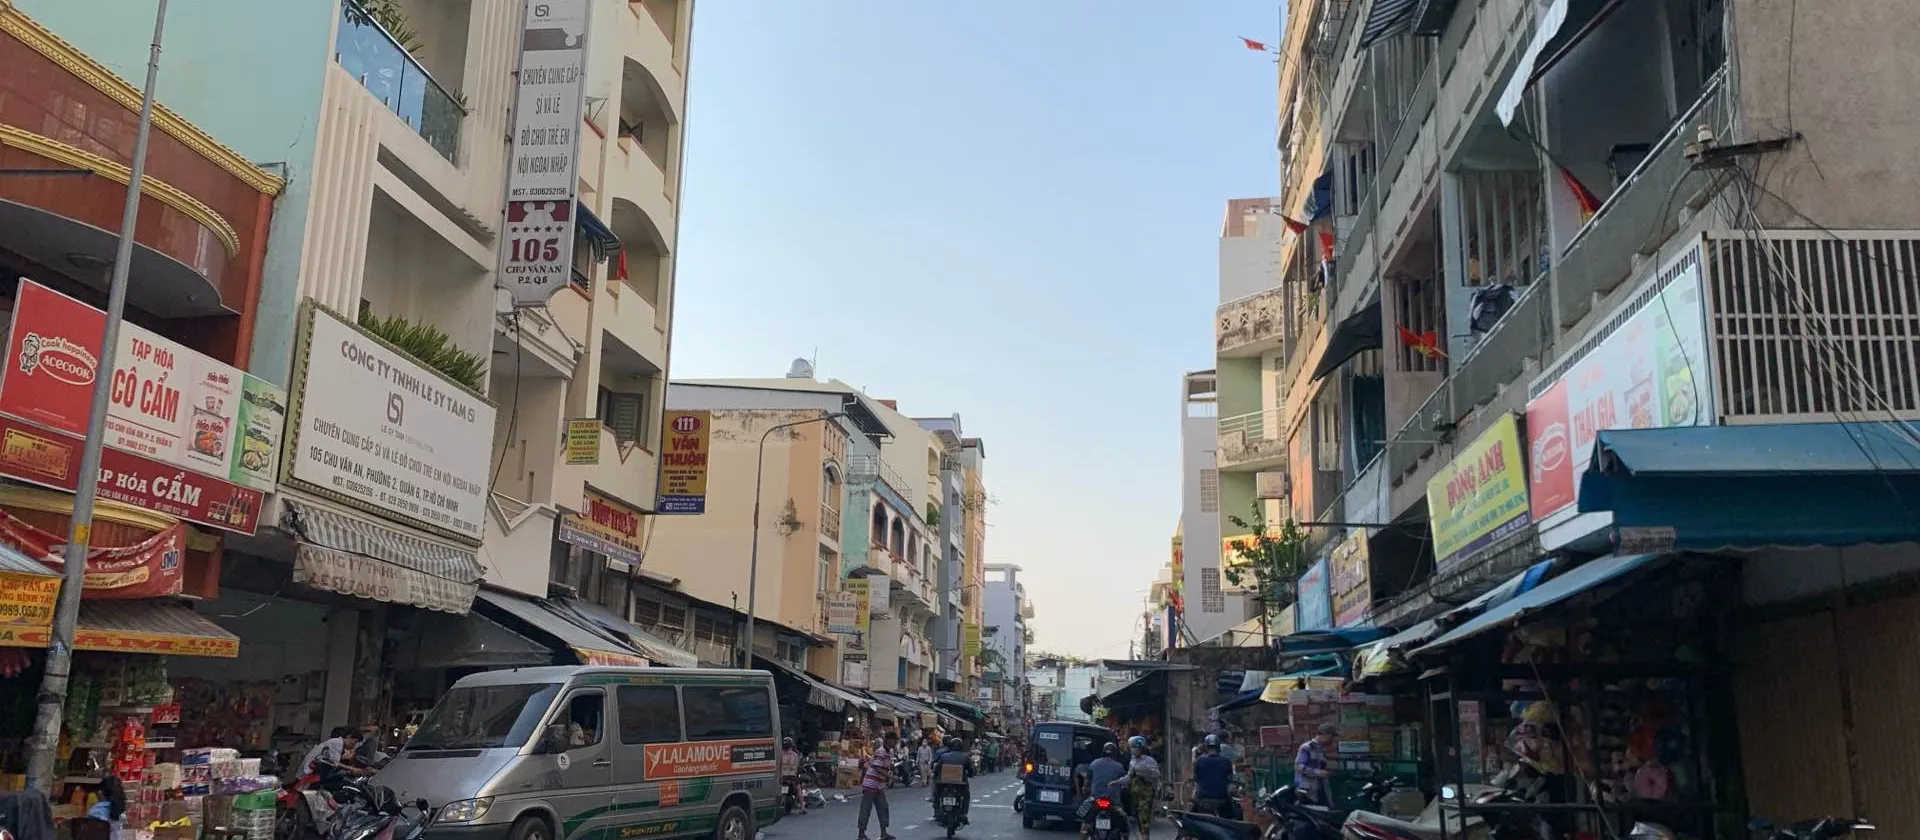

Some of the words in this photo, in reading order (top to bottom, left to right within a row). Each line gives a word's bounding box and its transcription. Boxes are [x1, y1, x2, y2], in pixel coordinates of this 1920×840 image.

[560, 128, 570, 146] EM
[510, 238, 559, 262] 105
[547, 266, 563, 274] AN
[132, 338, 152, 362] TẠP
[153, 347, 174, 371] HÓA
[377, 359, 391, 379] TY
[392, 368, 420, 396] TNHH
[111, 366, 138, 408] CÔ
[140, 371, 180, 423] CẨM
[676, 416, 695, 432] 111
[310, 445, 322, 462] 105
[323, 450, 339, 468] CHU
[116, 472, 139, 494] HÓA
[152, 471, 203, 508] CẨM
[662, 744, 731, 765] LALAMOVE
